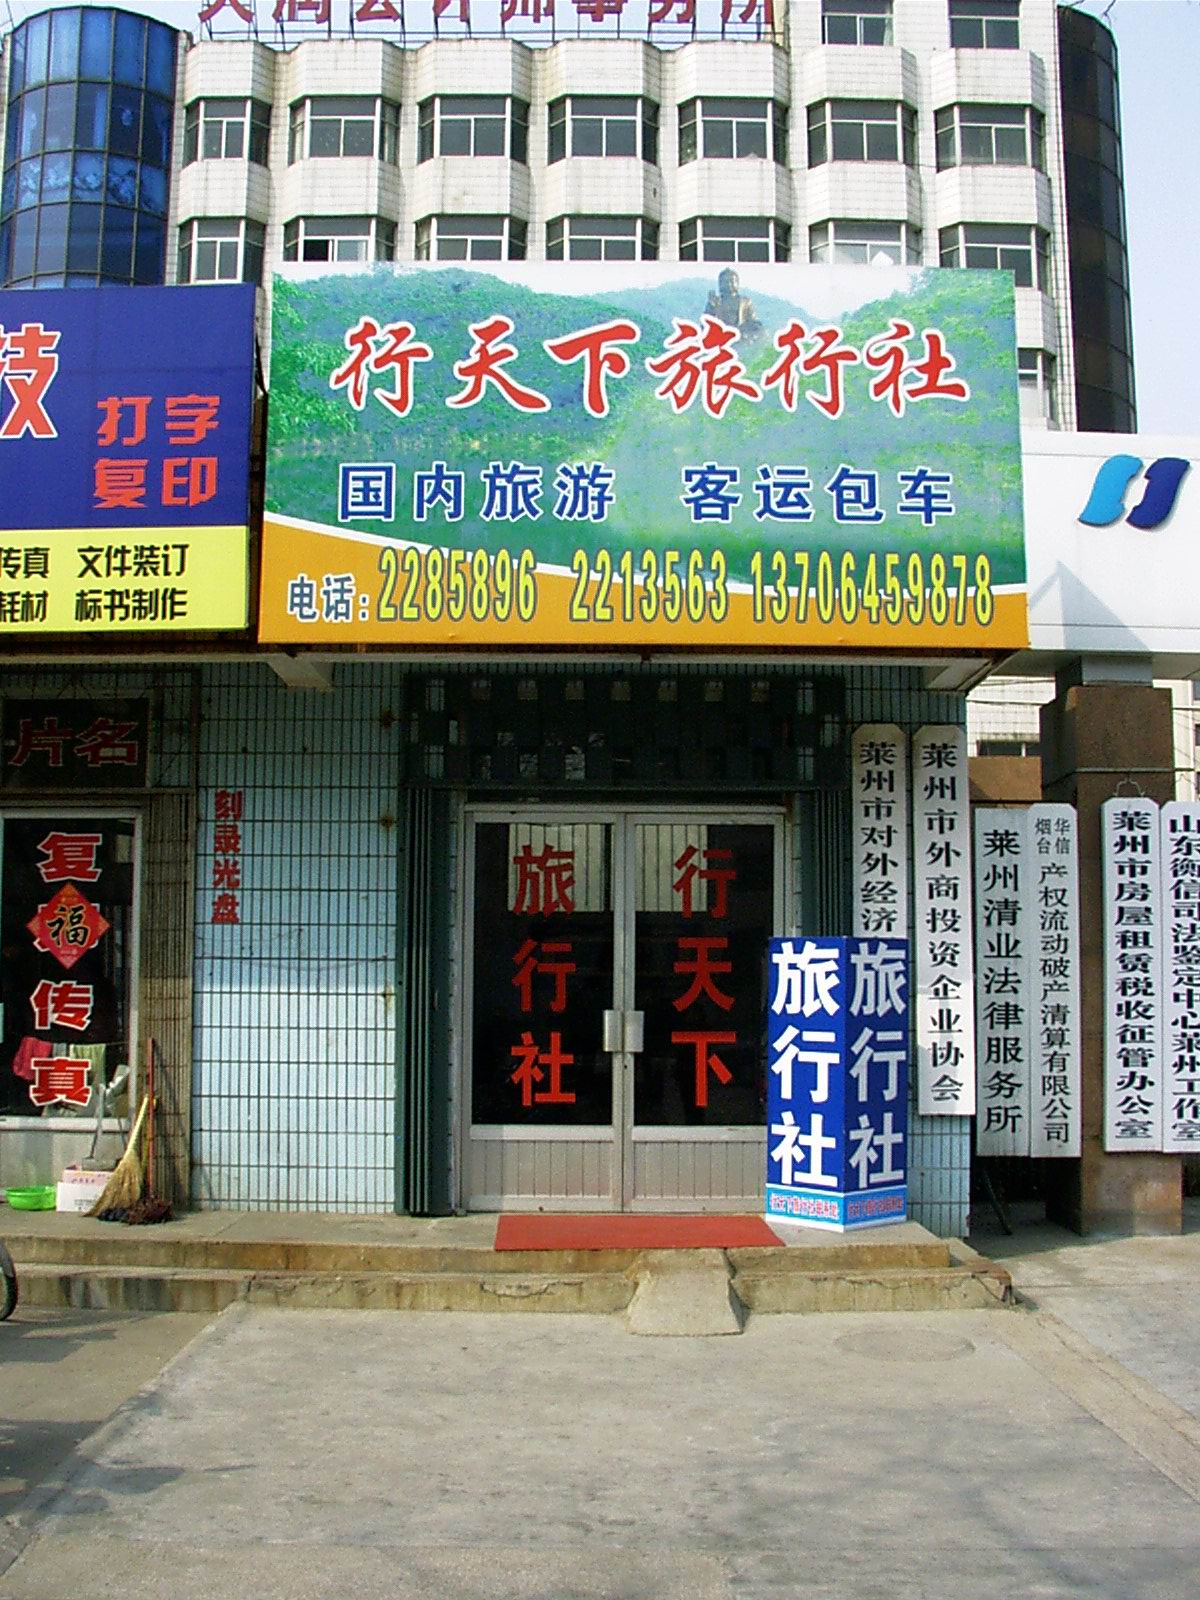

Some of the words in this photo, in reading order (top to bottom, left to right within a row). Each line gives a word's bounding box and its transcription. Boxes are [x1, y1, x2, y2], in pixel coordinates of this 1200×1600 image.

[0, 324, 61, 438] 技
[96, 393, 220, 446] 打字
[331, 316, 970, 417] 行天下旅行社
[77, 544, 189, 579] 文件装订
[93, 456, 218, 508] 复印
[339, 463, 615, 520] 国内旅游
[683, 464, 954, 525] 客运包车
[75, 588, 188, 622] 标书制作
[378, 547, 536, 621] 2285896
[570, 548, 728, 622] 2213563
[751, 550, 993, 625] 13706459878
[211, 789, 243, 925] 刻录光盘
[860, 742, 898, 932] 莱州市对外经济
[30, 832, 103, 1107] 复传真
[47, 904, 90, 947] 福
[511, 843, 577, 1107] 旅行社
[671, 844, 737, 1107] 行天下
[922, 743, 965, 1101] 莱州市外商投资企业协会
[983, 830, 1024, 1133] 莱州清业法律服务所
[1039, 863, 1072, 1143] 产权流动破产清算有限公司
[1113, 811, 1155, 1139] 莱州市房屋租赁税收征管办公室
[770, 941, 841, 1188] 旅行社
[849, 941, 907, 1189] 旅行社
